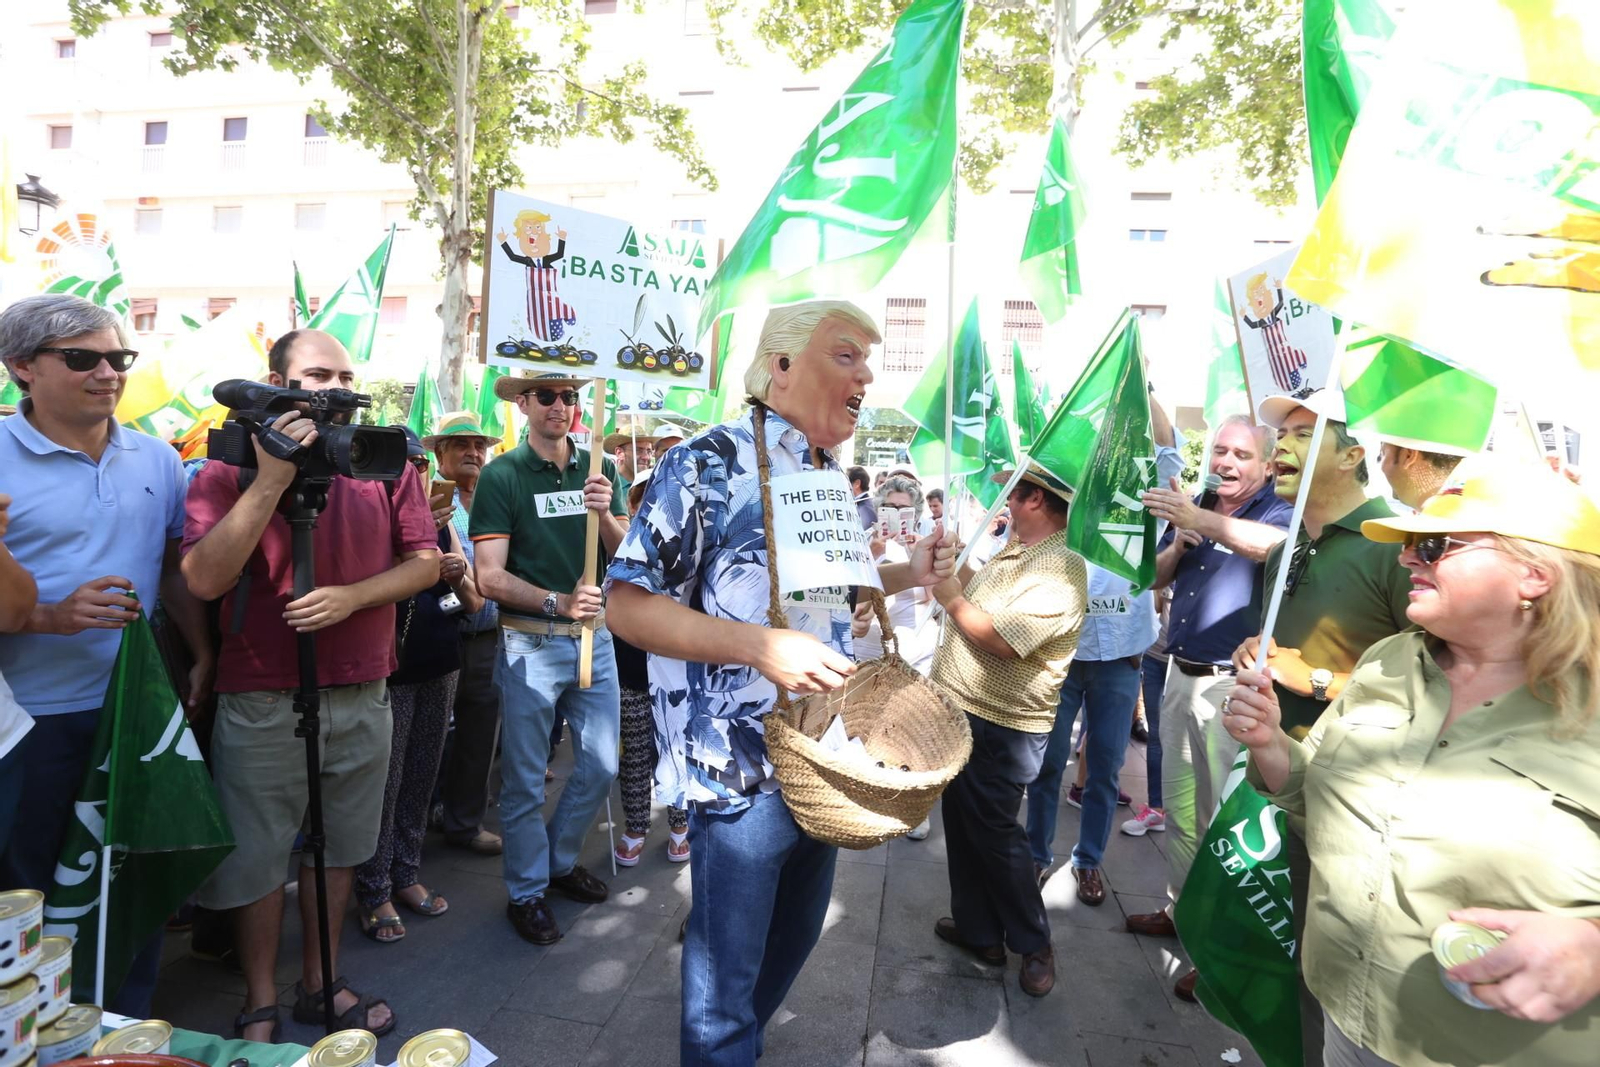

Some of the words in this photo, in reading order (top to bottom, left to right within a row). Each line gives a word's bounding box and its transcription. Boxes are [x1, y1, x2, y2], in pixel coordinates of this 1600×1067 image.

[616, 226, 706, 268] ASAJA
[561, 256, 660, 290] ¡BASTA
[543, 494, 587, 514] ASAJ
[780, 490, 811, 506] THE
[816, 489, 848, 502] BEST
[801, 509, 844, 523] OLIVE
[797, 530, 851, 545] WORLD
[808, 594, 840, 604] SEVILLA
[1209, 837, 1296, 960] SEVILLA
